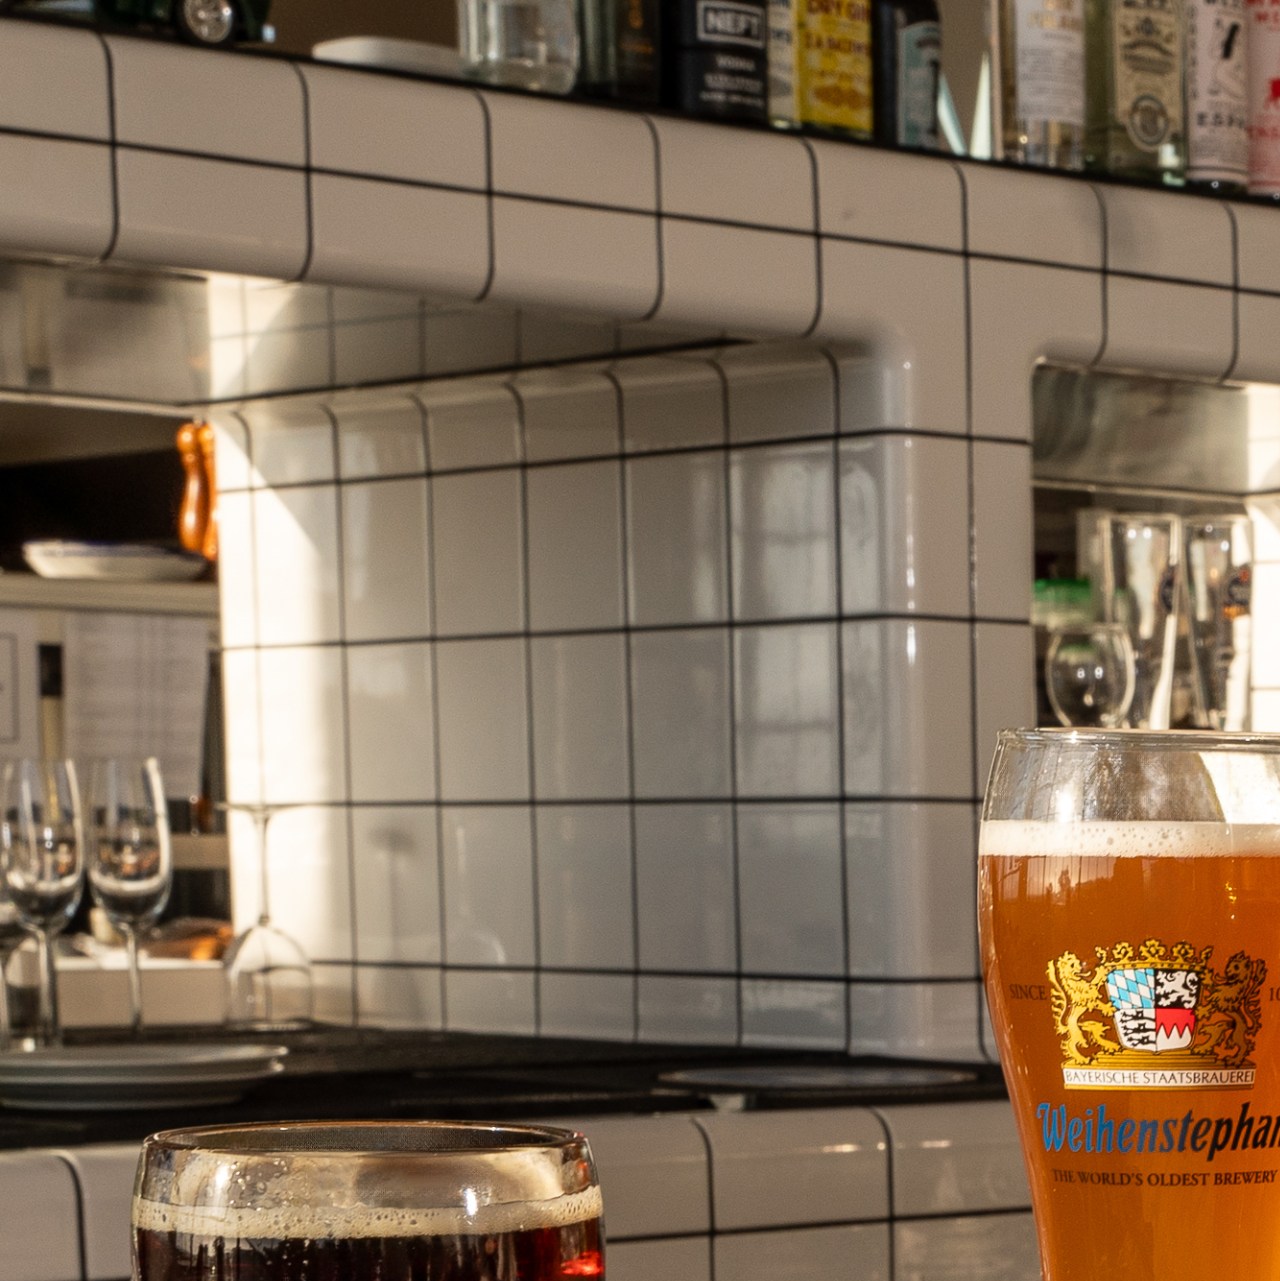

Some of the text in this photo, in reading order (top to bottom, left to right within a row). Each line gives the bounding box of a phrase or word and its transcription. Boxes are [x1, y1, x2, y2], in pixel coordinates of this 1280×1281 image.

[705, 10, 761, 38] NEFT
[1009, 982, 1047, 1001] SINCE
[1065, 1068, 1255, 1085] BAYERISCHE STAATSBRAUEREI
[1052, 1168, 1278, 1188] THE WORLD'S OLDEST BREWERY
